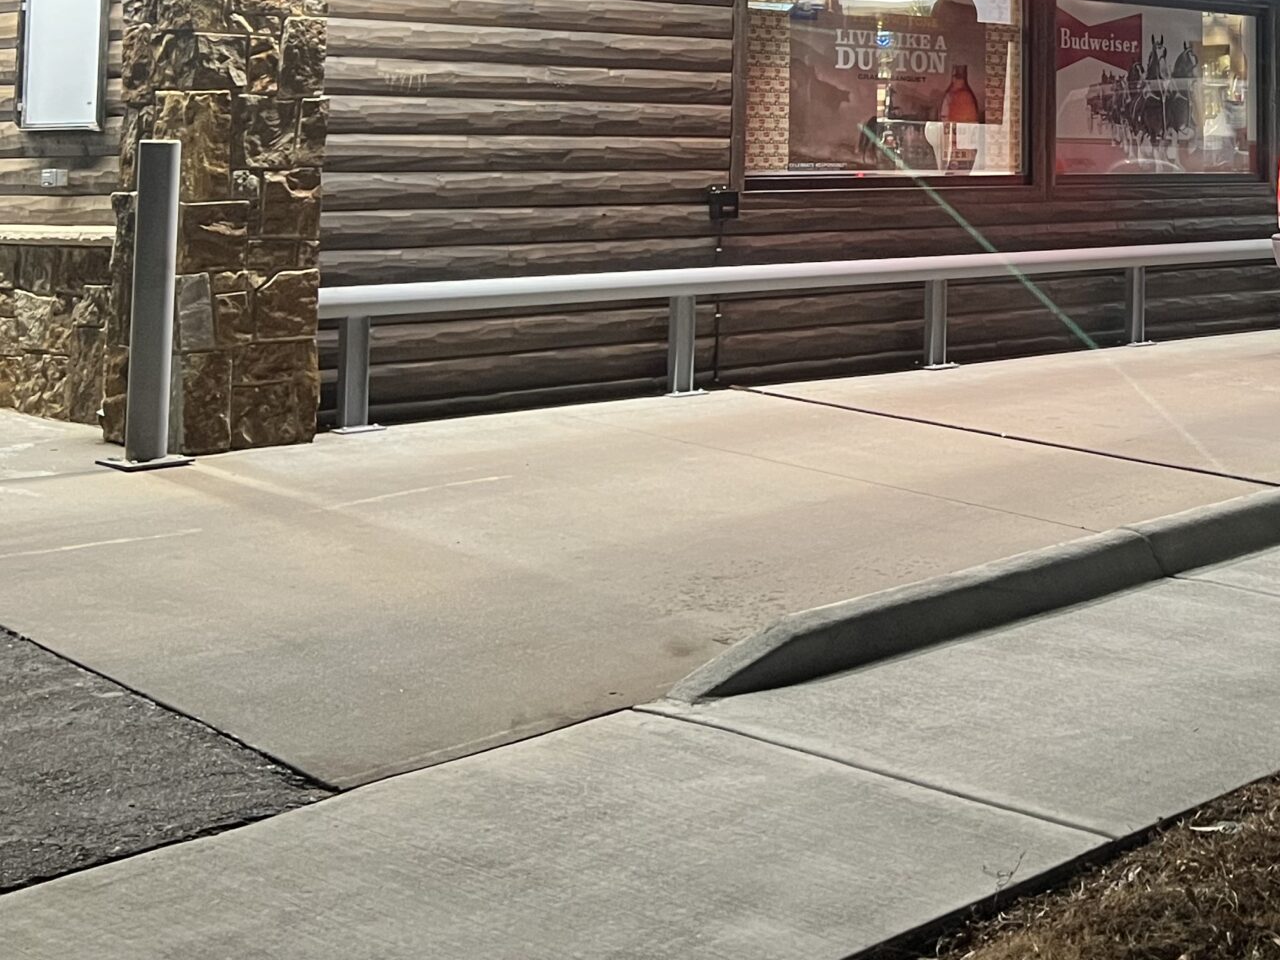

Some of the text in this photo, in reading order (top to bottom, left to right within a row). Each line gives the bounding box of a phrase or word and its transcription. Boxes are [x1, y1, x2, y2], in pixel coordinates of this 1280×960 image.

[887, 31, 930, 49] IKE
[935, 35, 947, 50] A
[1059, 27, 1138, 53] Budweiser
